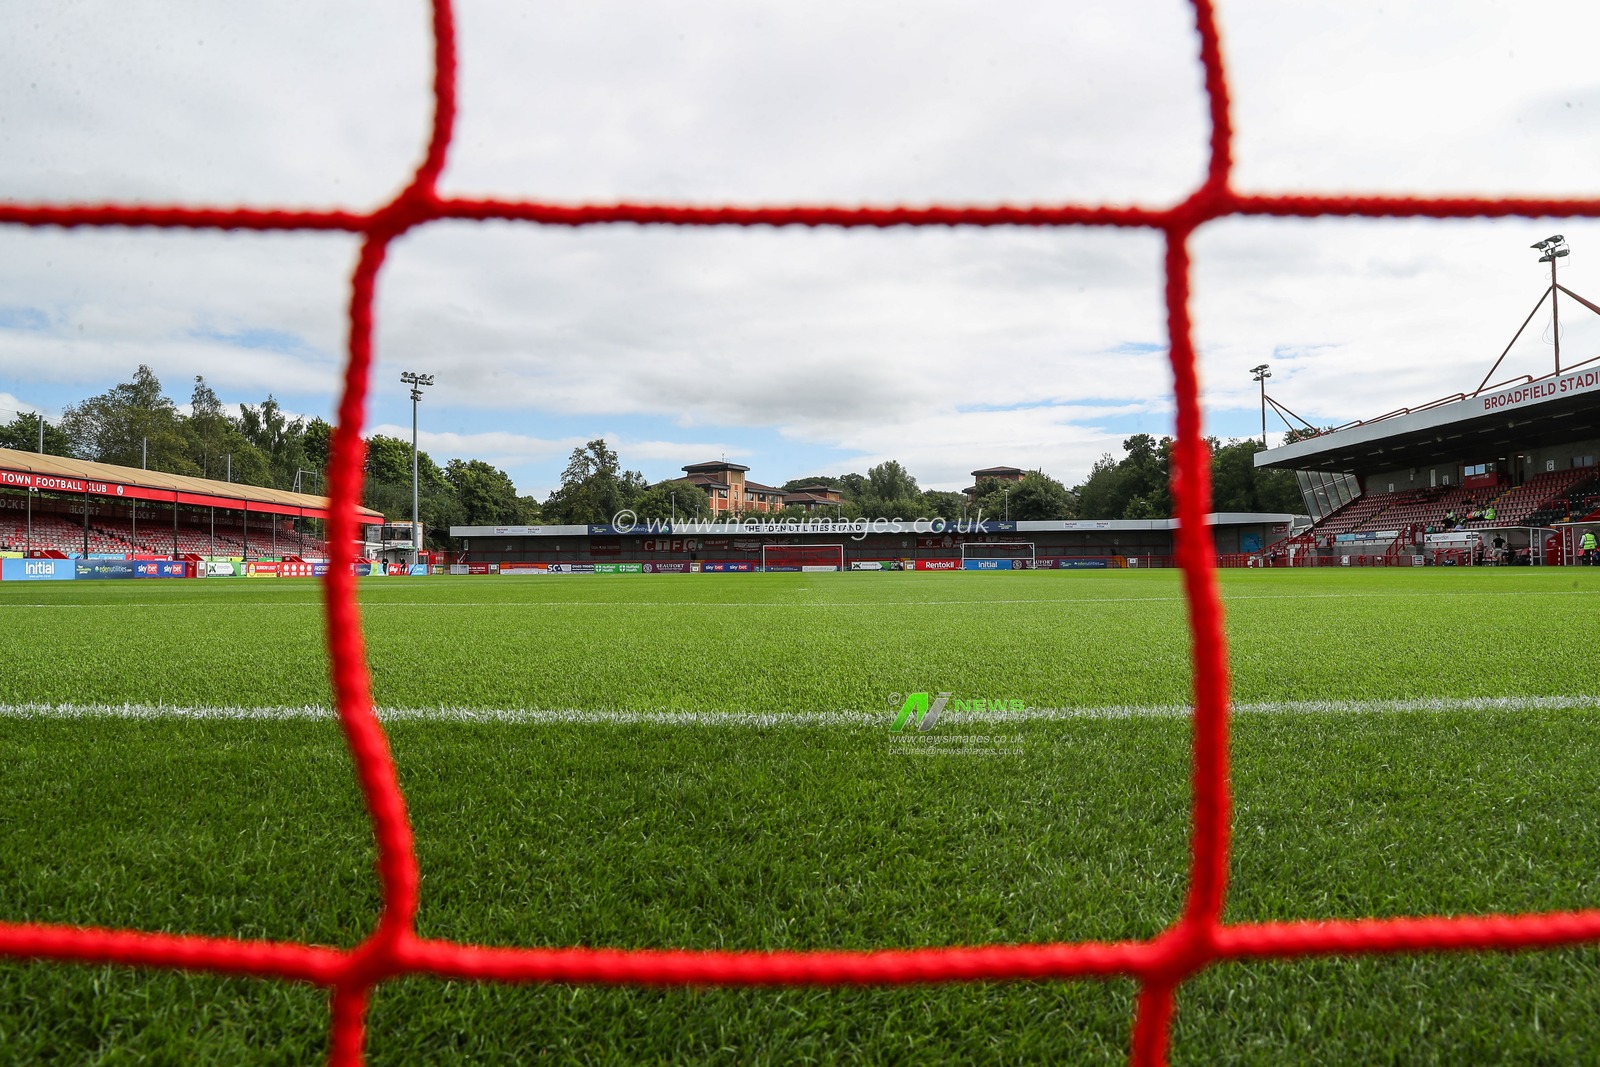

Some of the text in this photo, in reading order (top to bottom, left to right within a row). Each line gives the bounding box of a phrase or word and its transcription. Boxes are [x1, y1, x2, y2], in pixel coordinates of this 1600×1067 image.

[1484, 371, 1599, 409] BROADFIELD STADI
[1, 473, 107, 493] TOWN FOOTBALL CLUB
[25, 561, 55, 575] Initial
[138, 564, 157, 575] sky bet
[164, 564, 182, 575] sky bet
